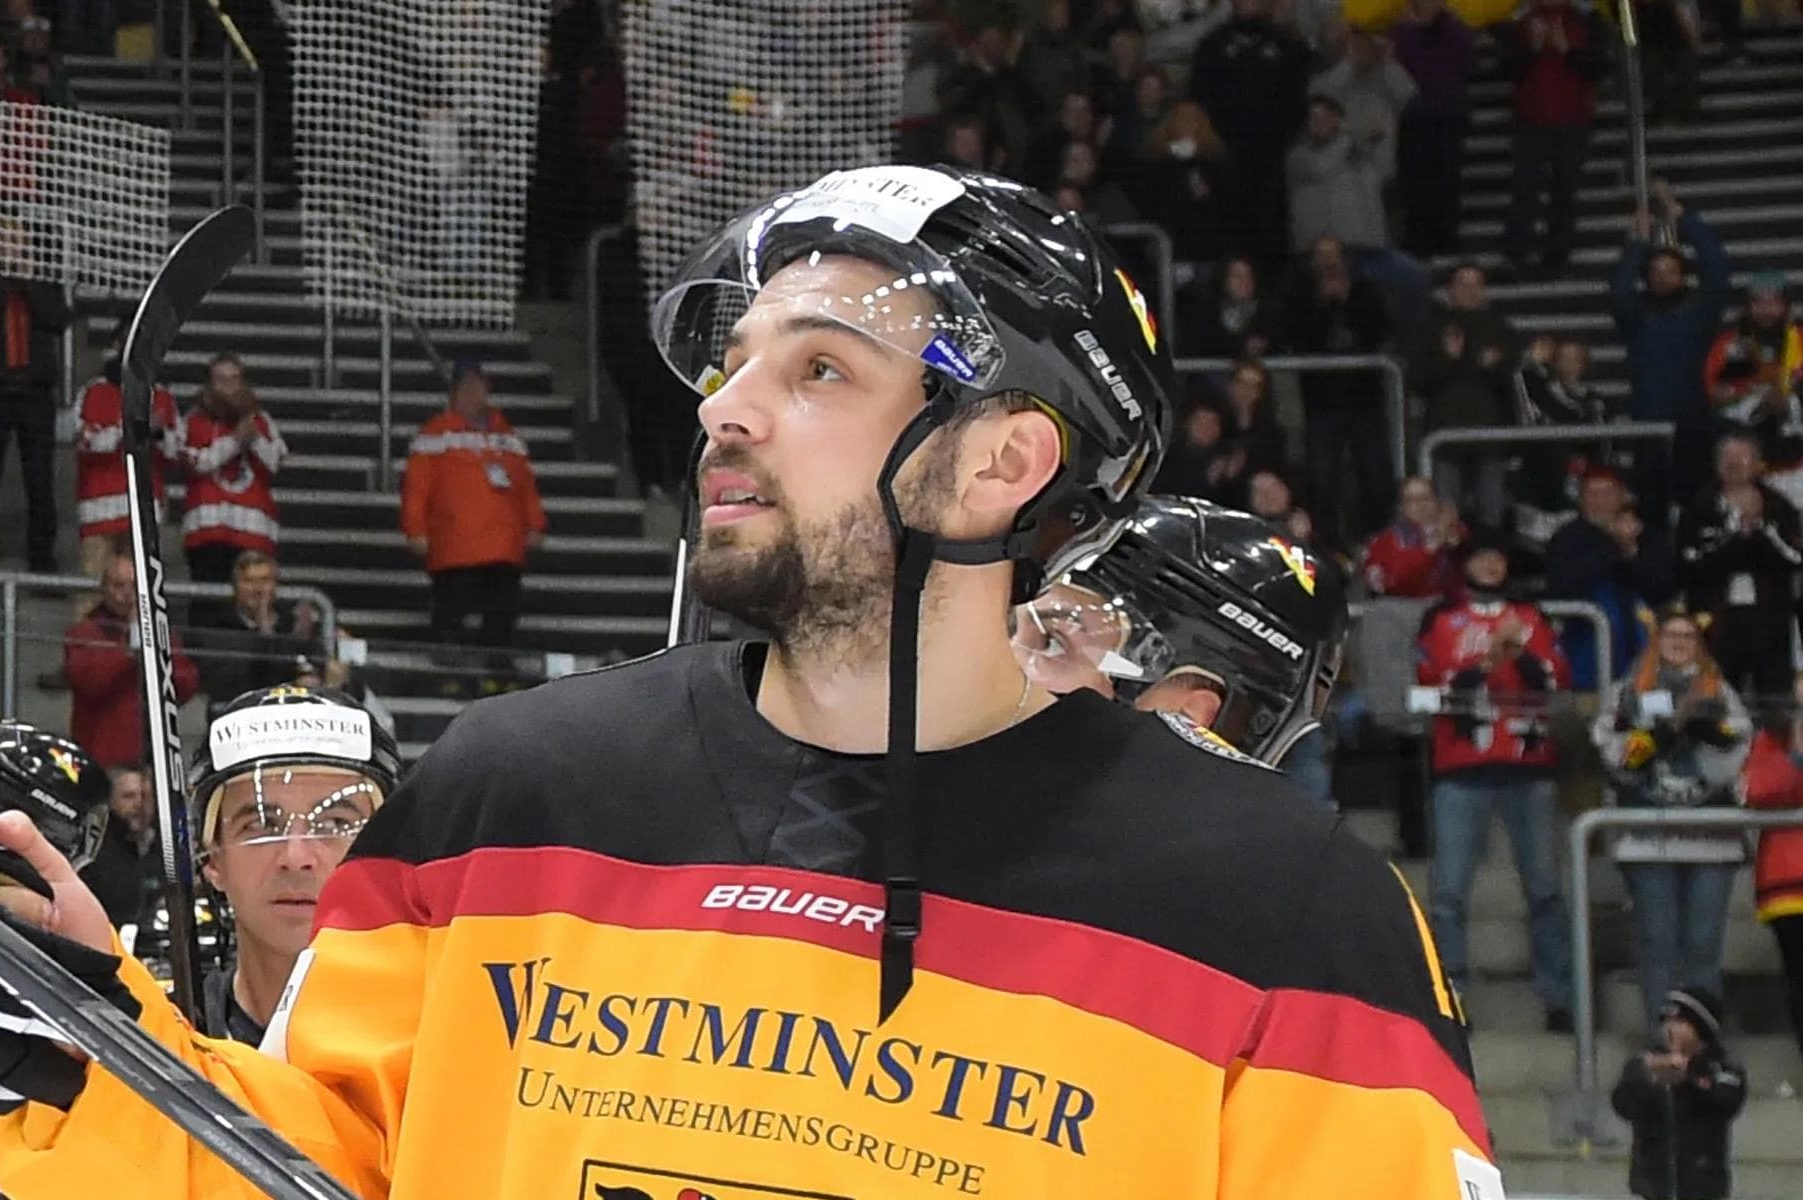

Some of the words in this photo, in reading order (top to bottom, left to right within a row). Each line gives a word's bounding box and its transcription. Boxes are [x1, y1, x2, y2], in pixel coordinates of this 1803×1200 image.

[148, 555, 185, 794] NEXUS
[482, 957, 1097, 1157] WESTMINSTER
[514, 1066, 988, 1196] UNTERNEHMENSGRUPPE
